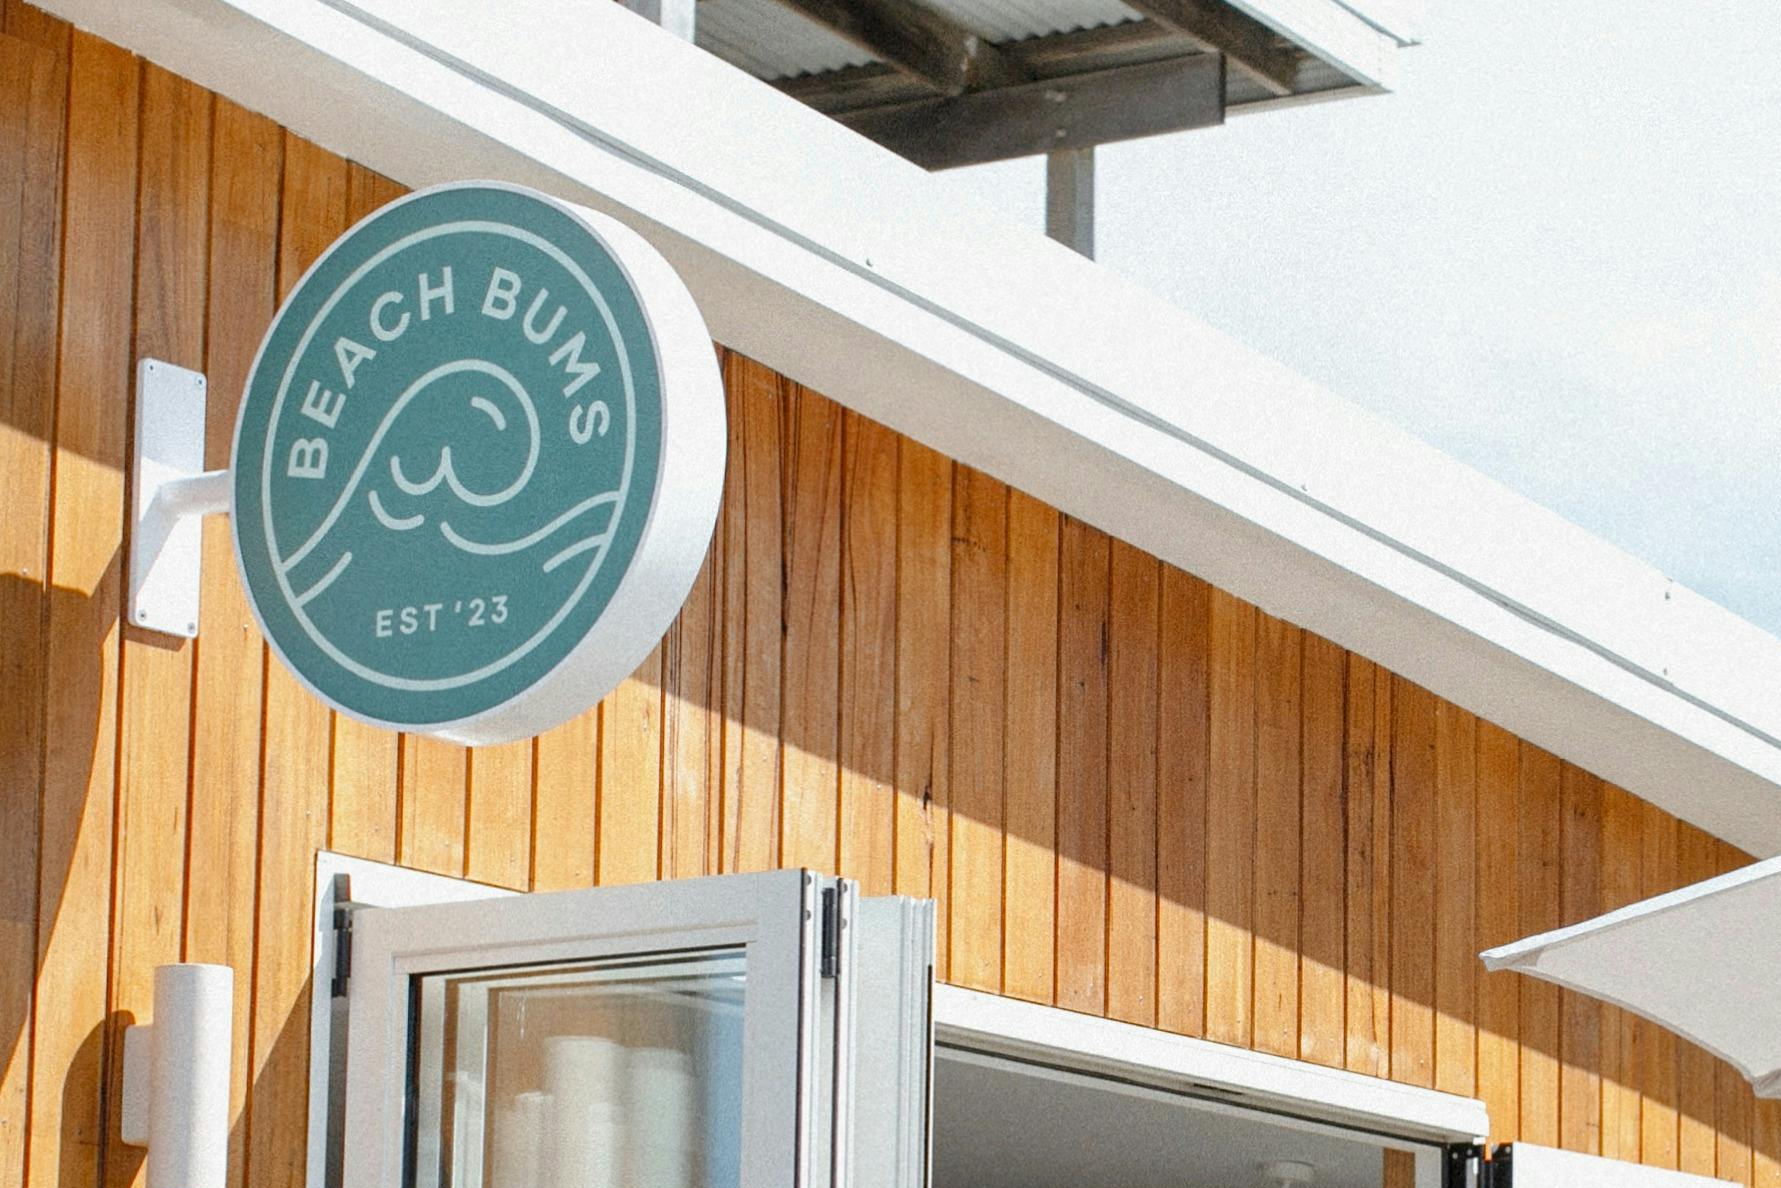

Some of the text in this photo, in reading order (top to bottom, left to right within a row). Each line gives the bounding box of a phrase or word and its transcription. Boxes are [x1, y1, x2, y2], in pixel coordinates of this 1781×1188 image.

[287, 265, 611, 480] BEACH BUMS
[376, 595, 508, 637] EST '23
